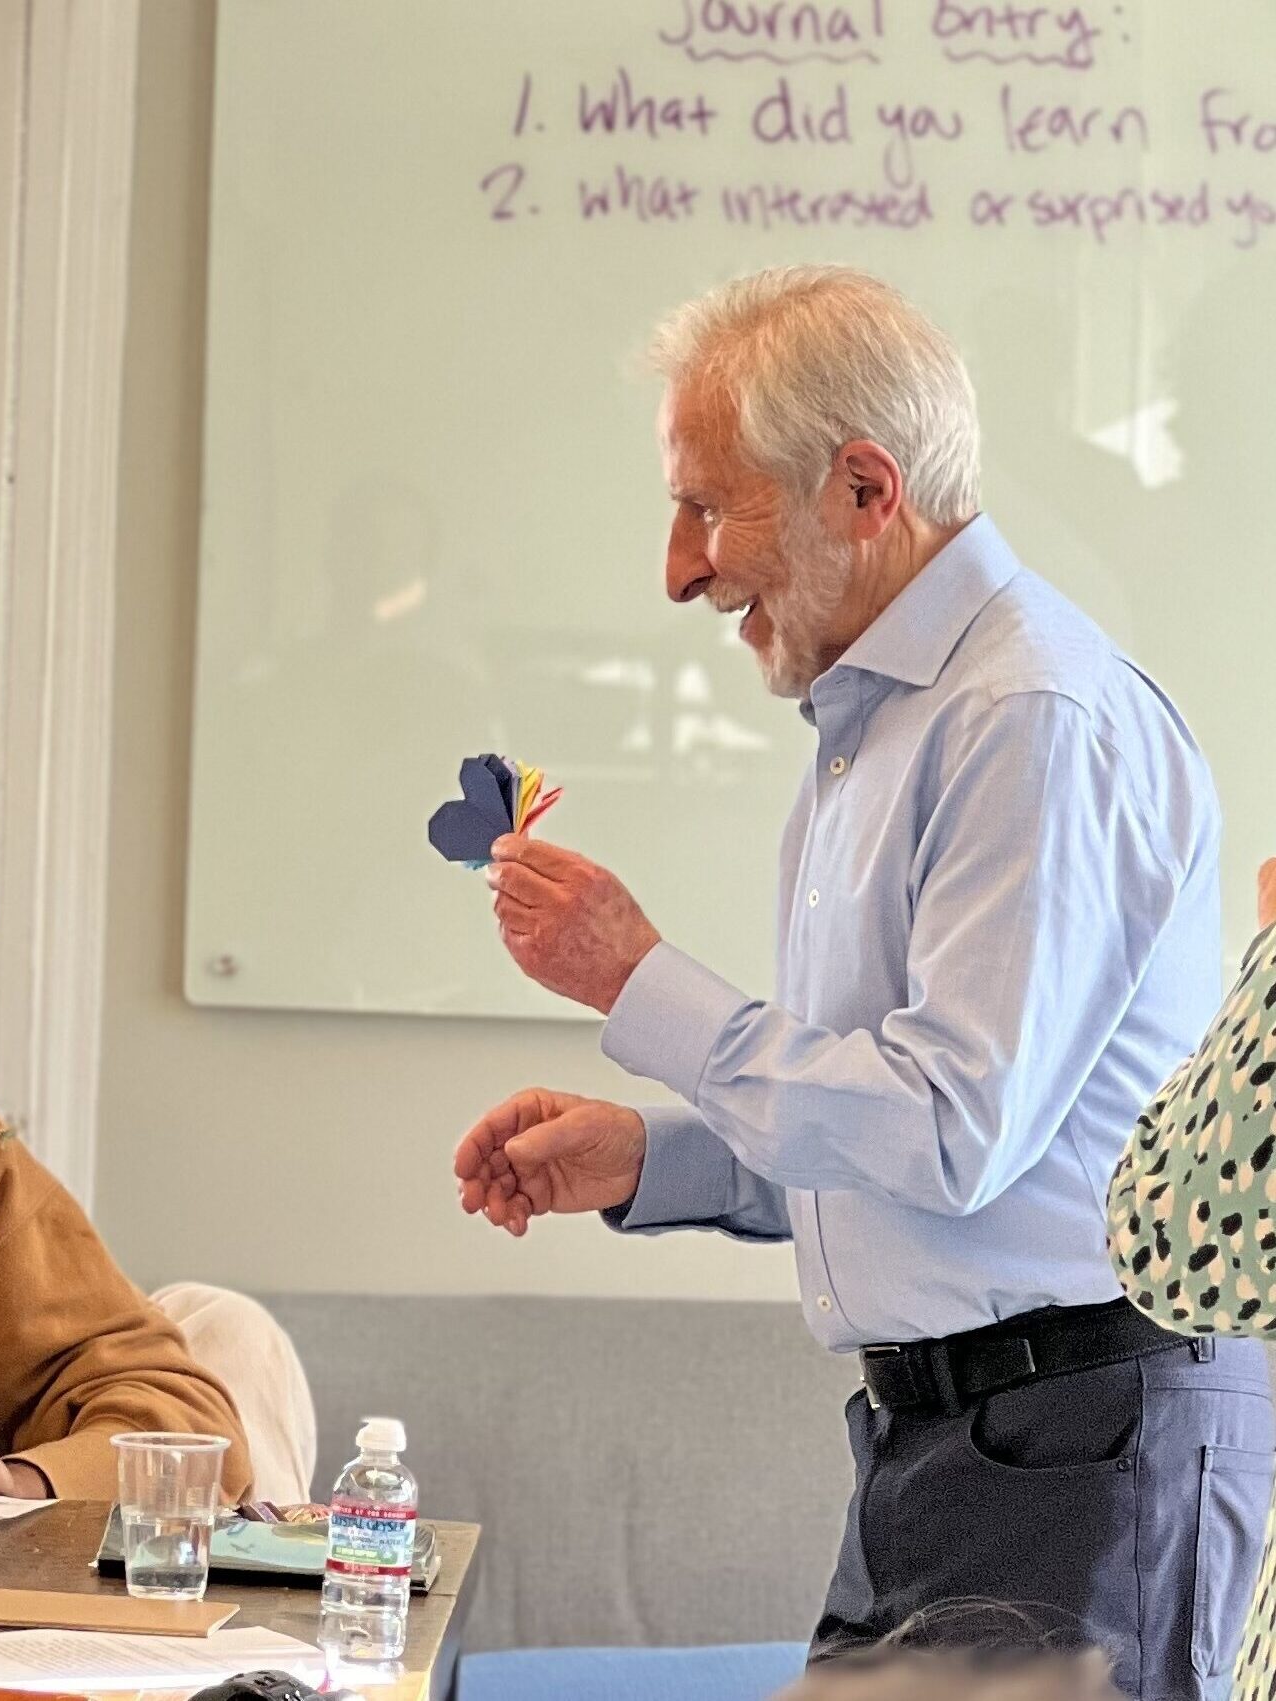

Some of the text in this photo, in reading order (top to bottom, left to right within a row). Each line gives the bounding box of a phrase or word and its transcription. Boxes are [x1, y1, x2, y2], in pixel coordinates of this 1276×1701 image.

[660, 0, 883, 44] Journal
[513, 72, 545, 137] 1.
[752, 77, 852, 144] did
[877, 103, 962, 190] you
[1001, 82, 1148, 153] learn
[480, 162, 541, 220] 2.
[970, 190, 1014, 227] or
